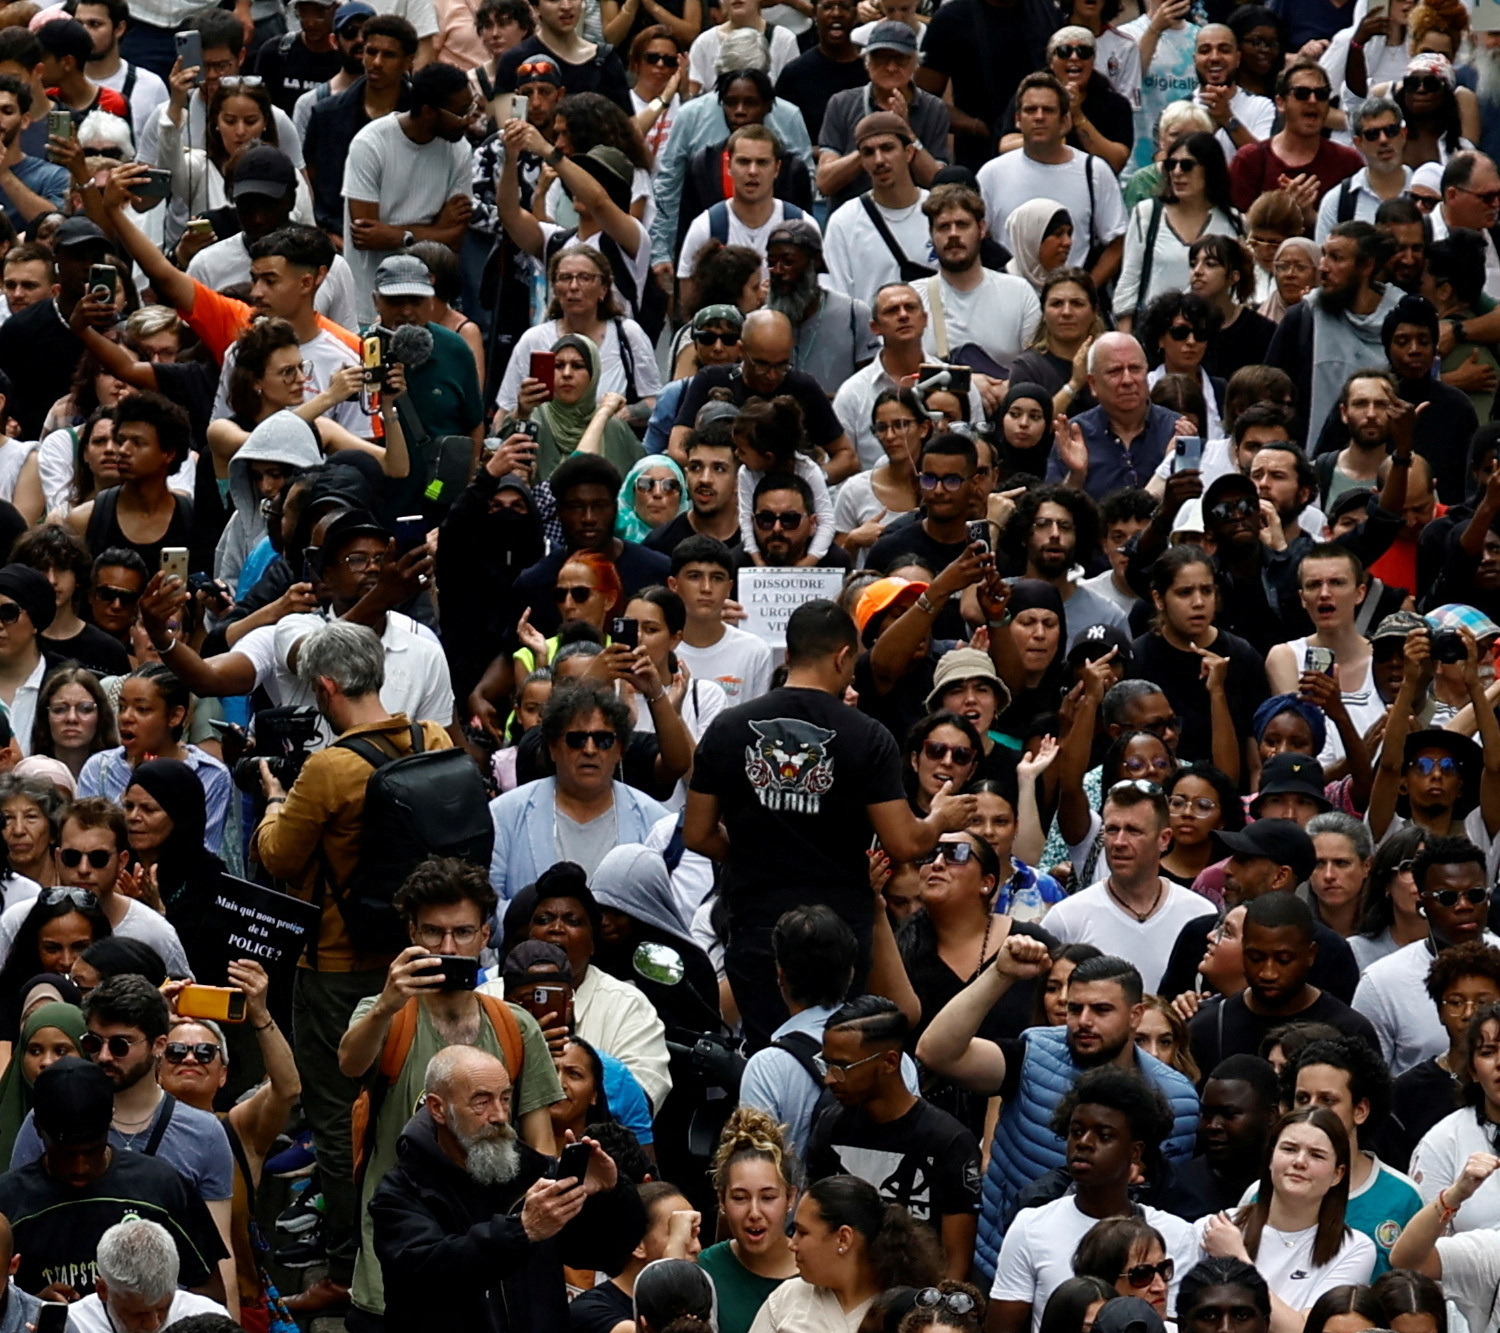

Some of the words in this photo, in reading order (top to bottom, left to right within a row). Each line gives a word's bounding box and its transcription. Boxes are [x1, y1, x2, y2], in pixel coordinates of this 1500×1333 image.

[753, 577, 826, 591] DISSOUDRE
[752, 592, 769, 605] LA
[214, 896, 238, 914] Mais
[238, 905, 257, 921] qui
[255, 911, 278, 927] nous
[276, 916, 306, 937] protège
[247, 922, 259, 935] de
[258, 926, 270, 939] la
[227, 933, 276, 959] POLICE
[41, 1260, 99, 1287] TRAPST
